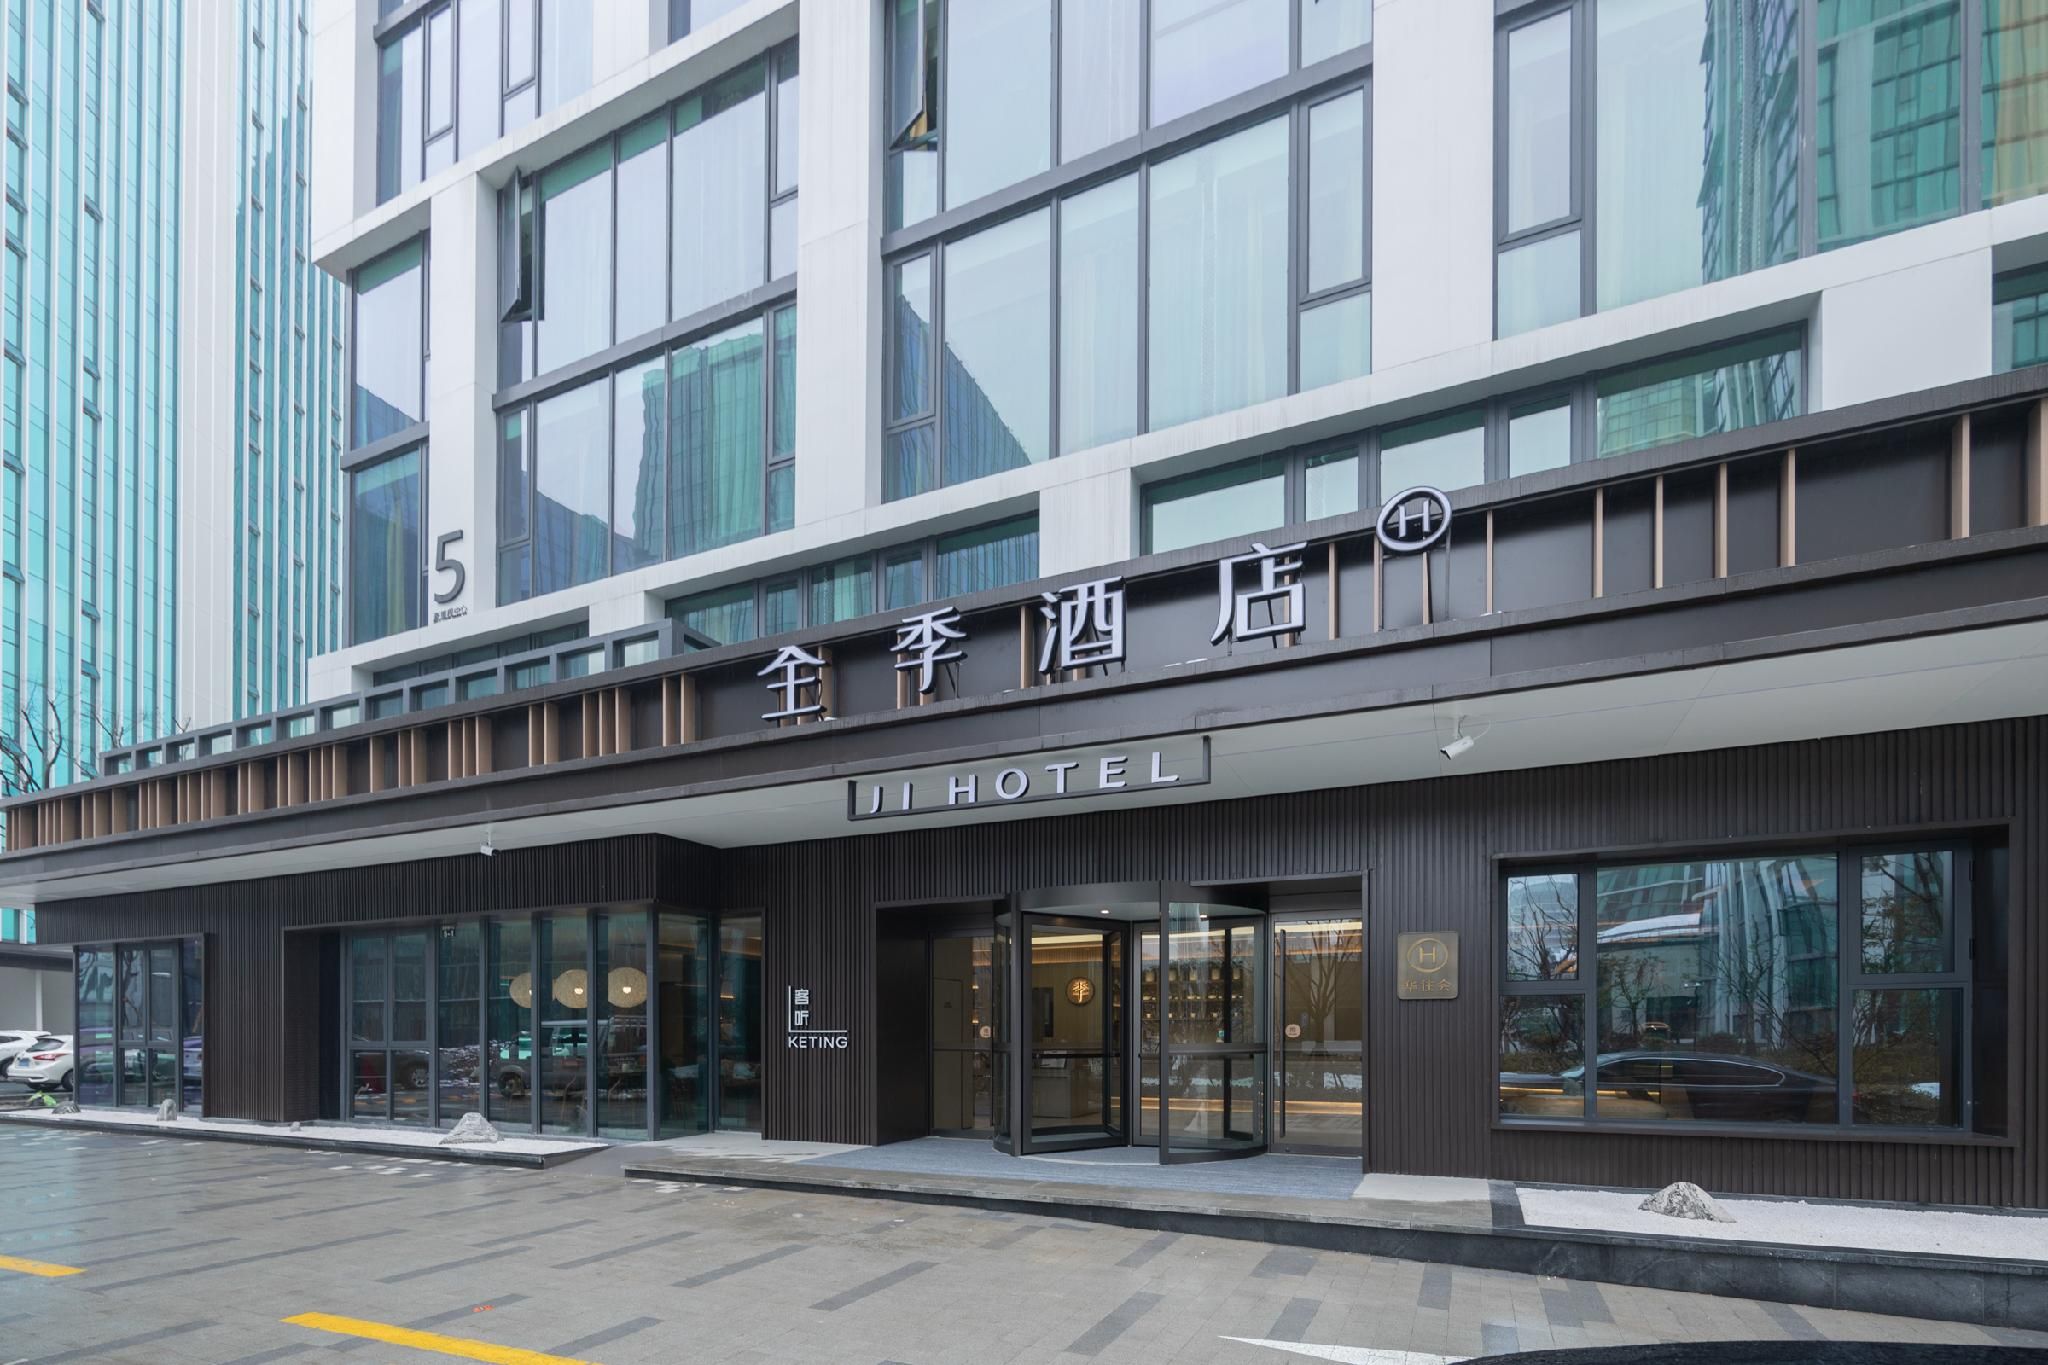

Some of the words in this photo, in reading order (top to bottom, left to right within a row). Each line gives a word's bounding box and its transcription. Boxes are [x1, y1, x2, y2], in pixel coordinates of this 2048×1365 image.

[433, 529, 466, 604] 5
[756, 541, 1308, 720] 全季酒店
[869, 781, 913, 814] JI
[948, 751, 1180, 805] HOTEL
[788, 1036, 848, 1049] KETING
